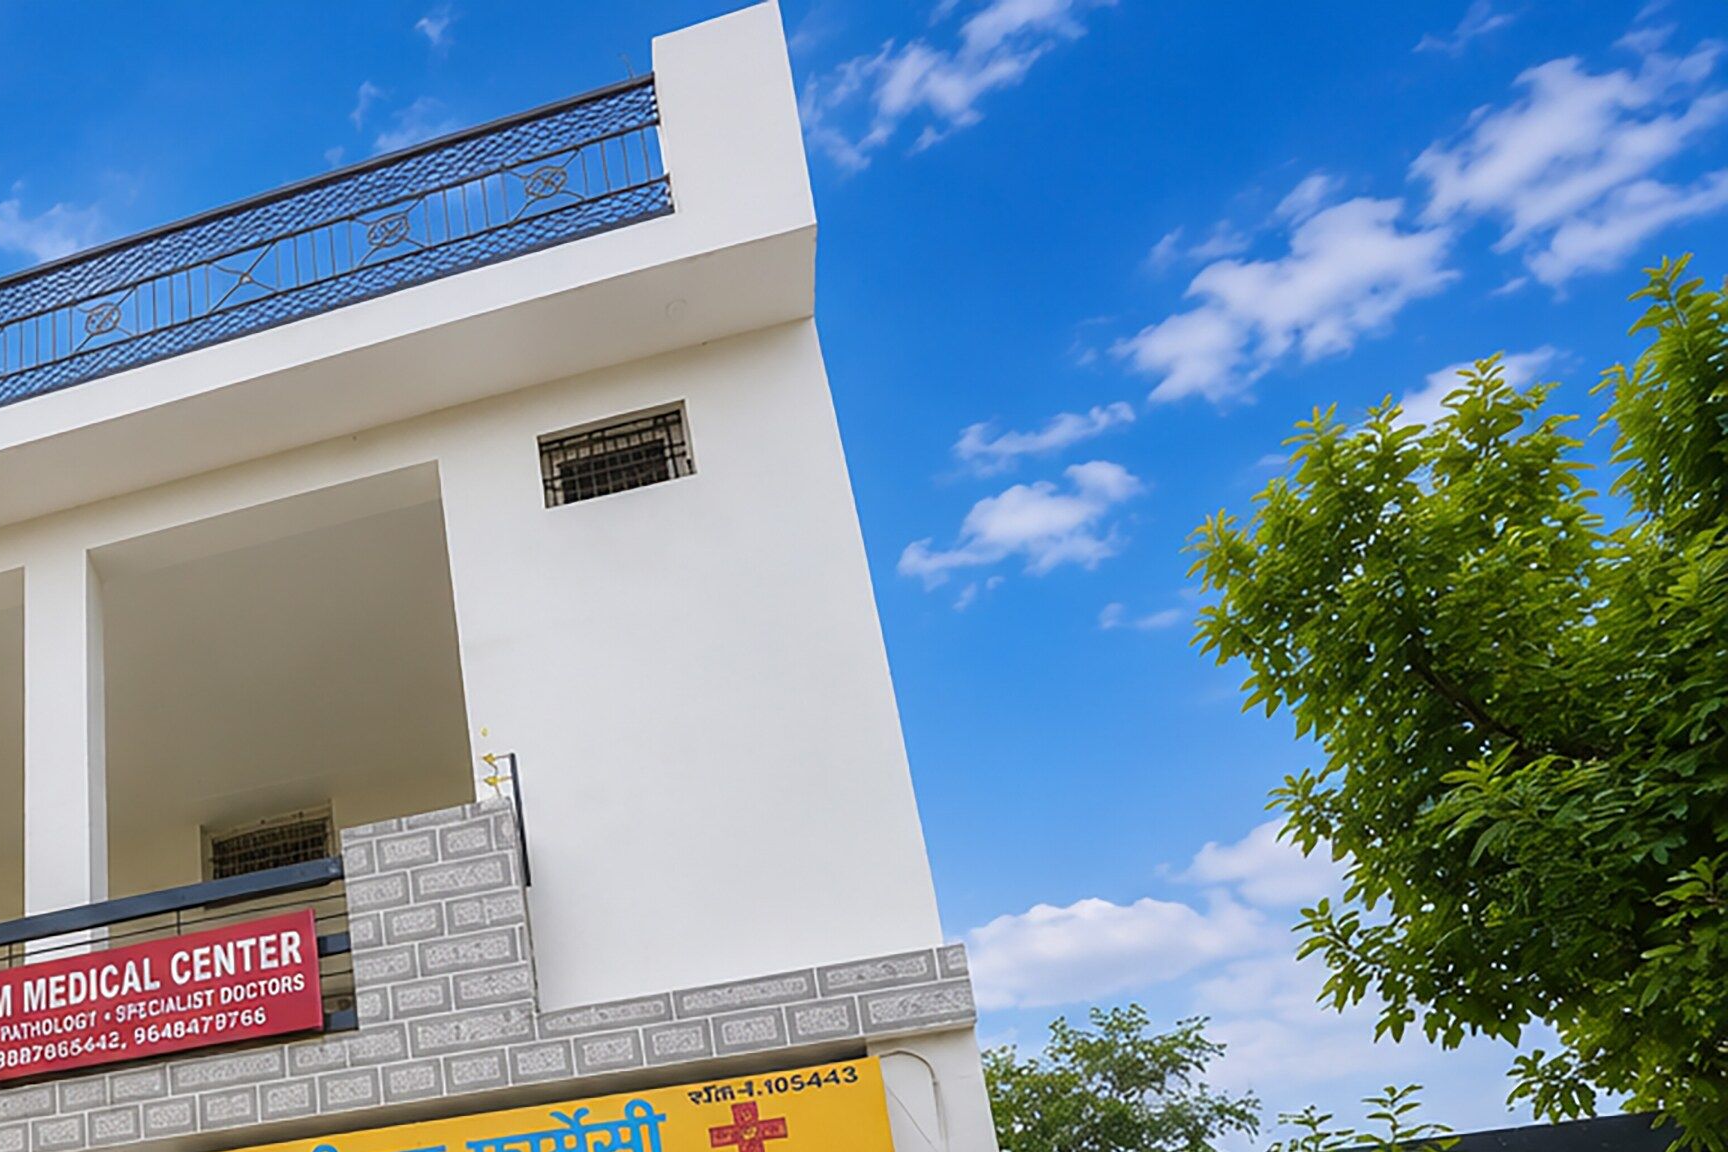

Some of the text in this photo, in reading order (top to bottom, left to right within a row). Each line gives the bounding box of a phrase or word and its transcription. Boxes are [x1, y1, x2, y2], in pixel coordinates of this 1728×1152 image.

[23, 959, 161, 1014] MEDICAL
[172, 930, 303, 987] CENTER
[220, 973, 306, 1005] DOCTORS
